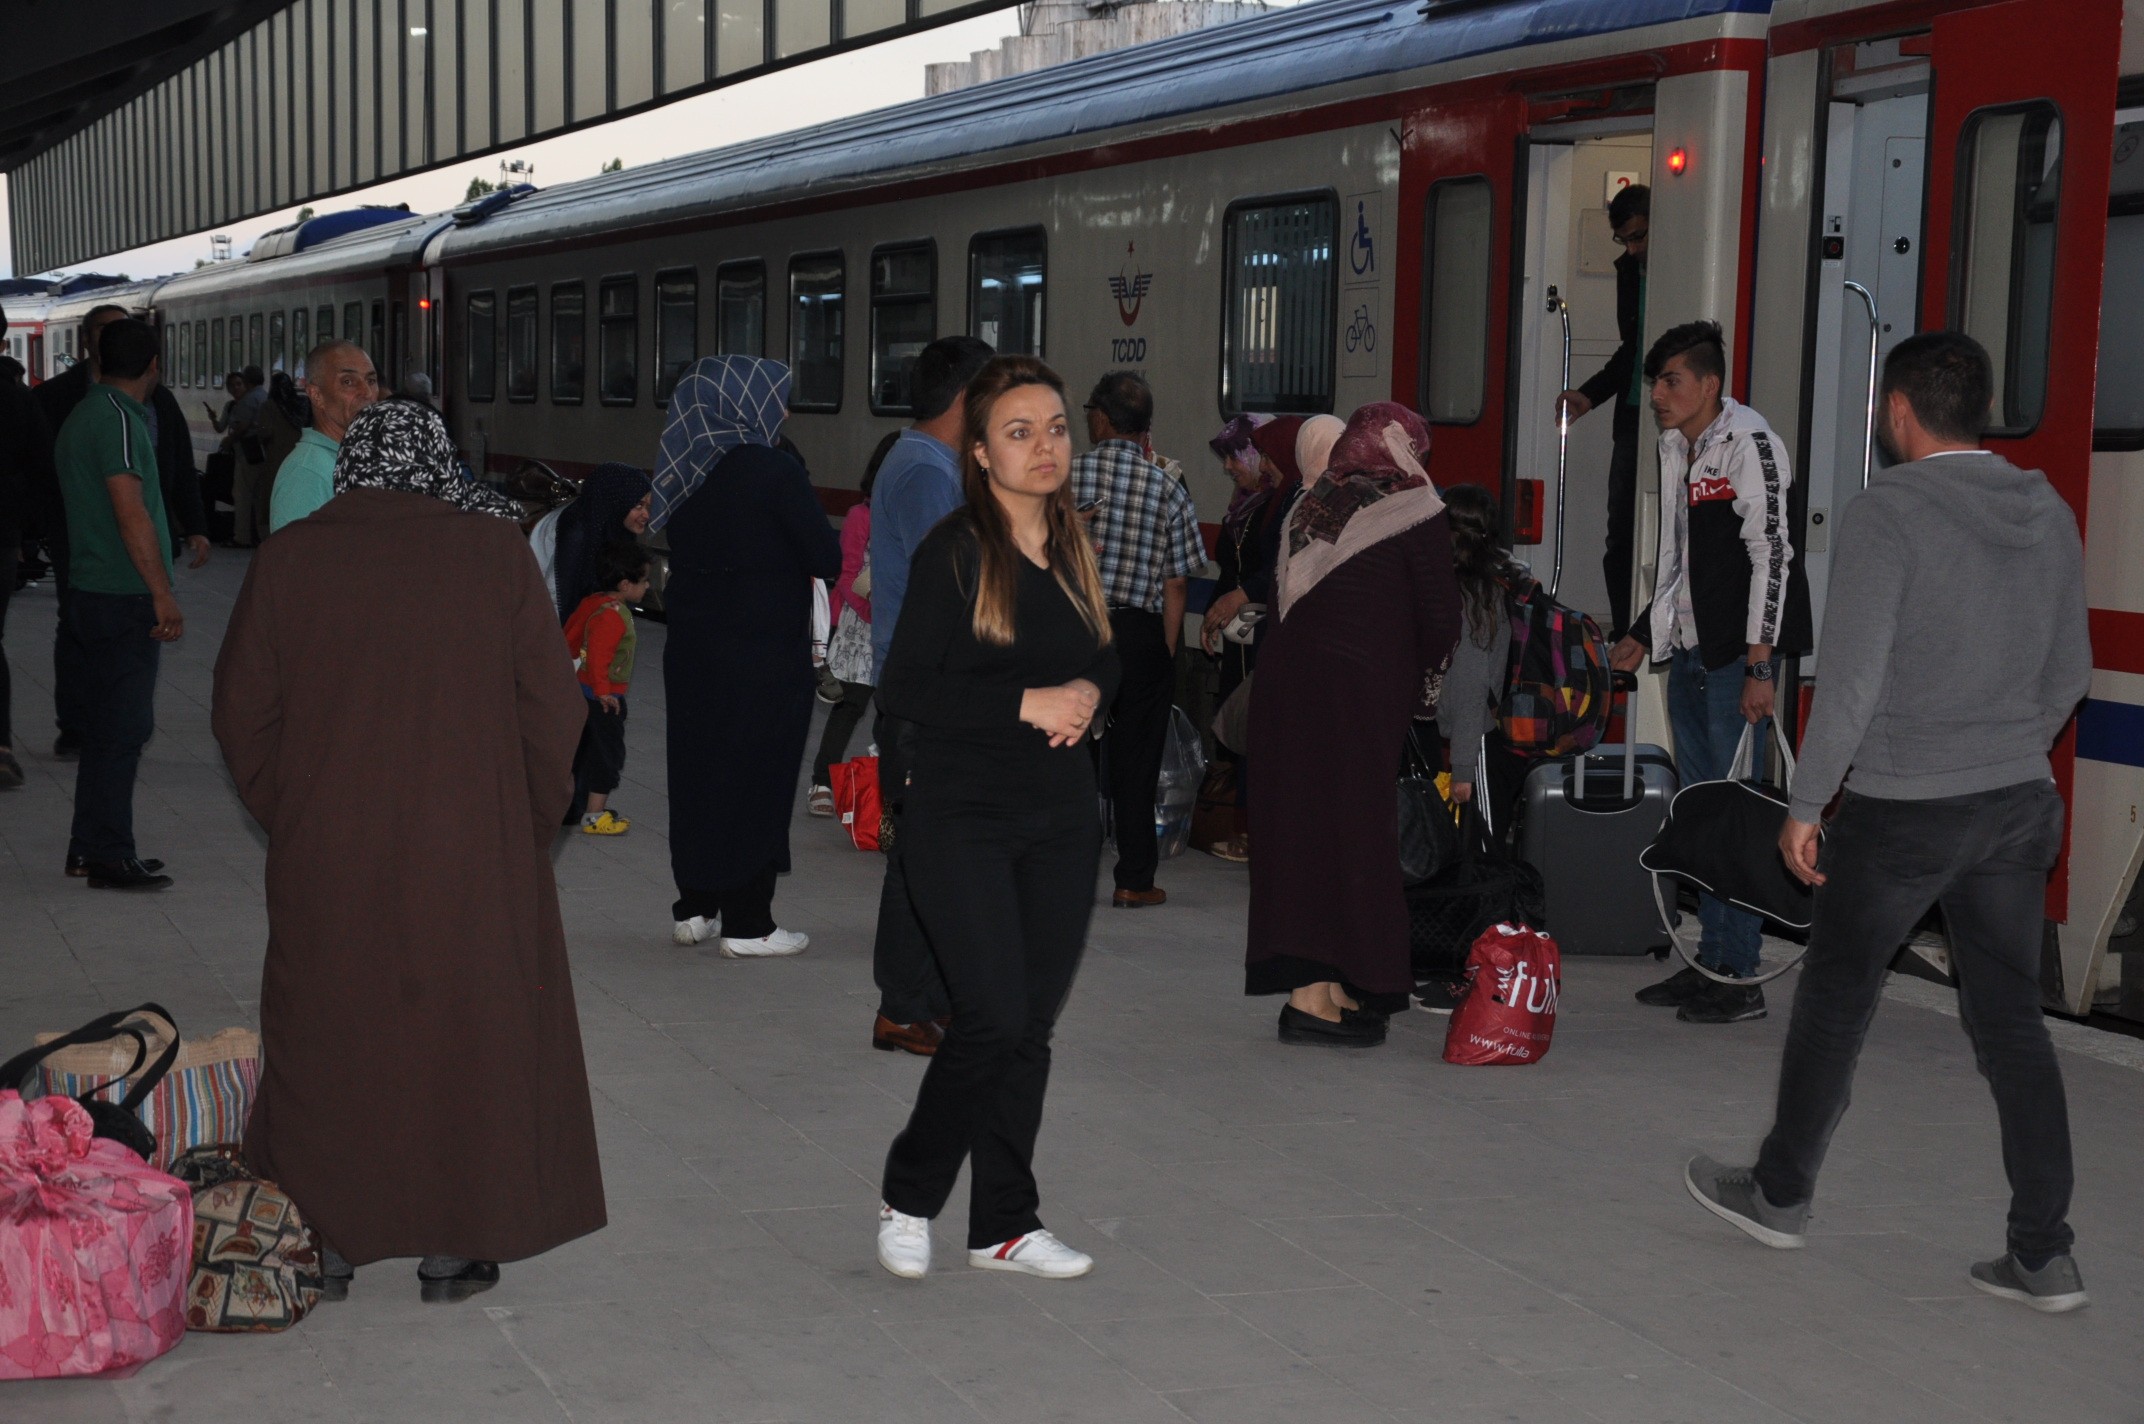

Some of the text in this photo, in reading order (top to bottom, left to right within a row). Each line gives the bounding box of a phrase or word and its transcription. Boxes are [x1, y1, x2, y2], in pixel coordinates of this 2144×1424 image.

[1112, 337, 1147, 363] TCDD
[1703, 465, 1719, 476] IKE
[2130, 805, 2137, 823] 5
[1502, 1026, 1532, 1040] ONLINE
[1469, 1033, 1530, 1059] www.fulla
